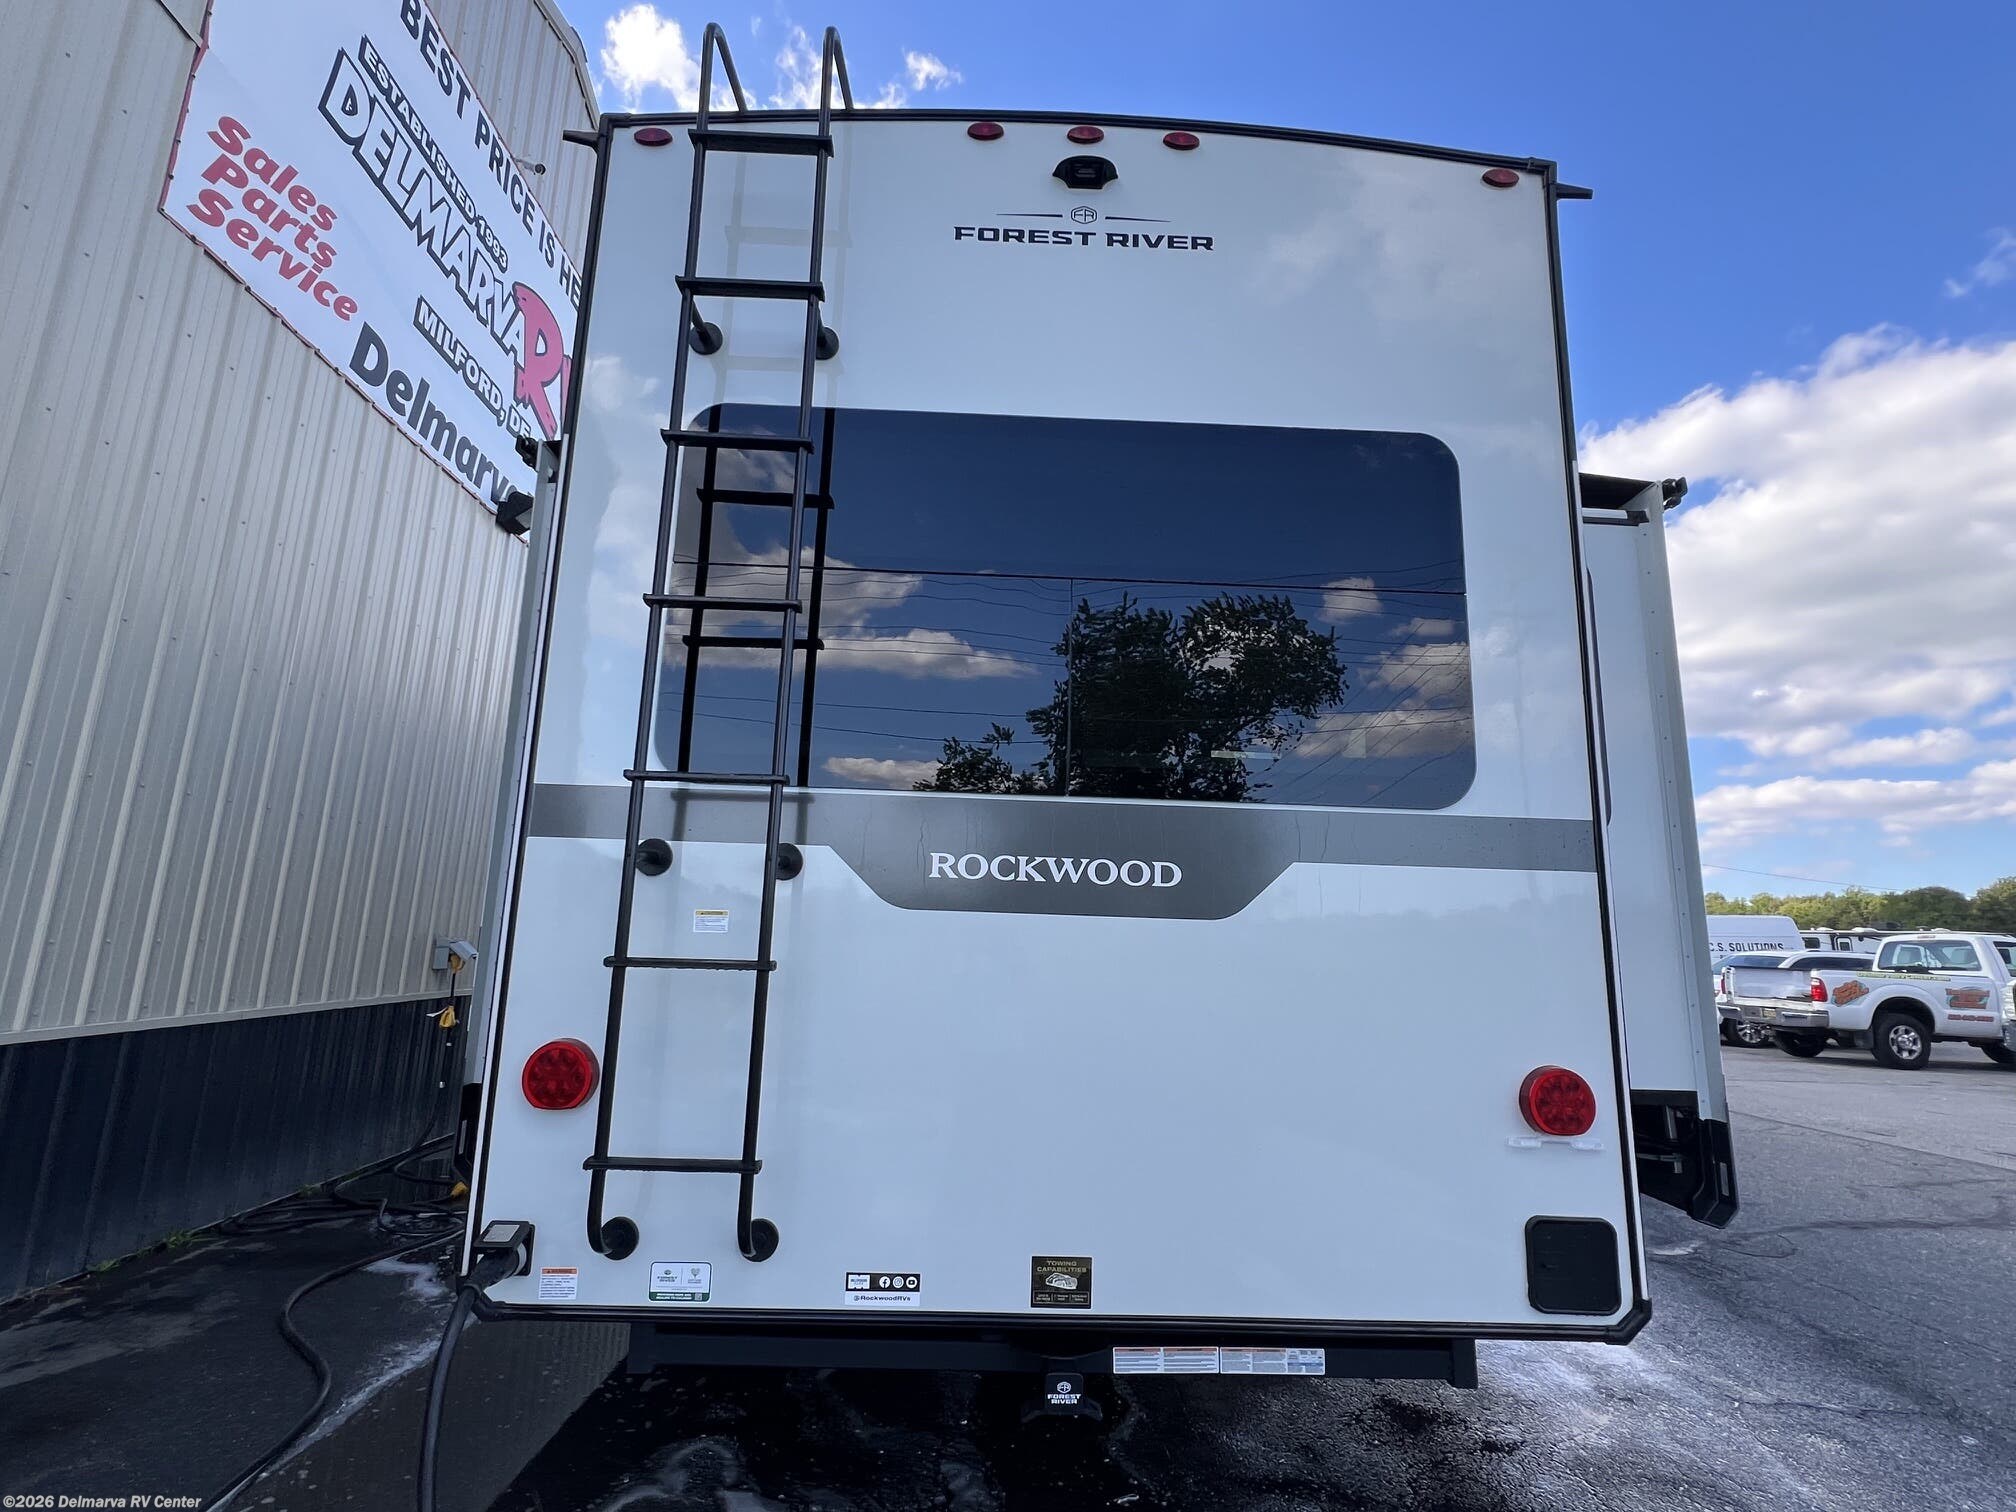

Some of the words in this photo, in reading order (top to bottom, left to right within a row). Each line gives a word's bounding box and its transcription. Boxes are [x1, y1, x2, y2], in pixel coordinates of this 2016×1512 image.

[207, 116, 338, 231] Sales
[359, 36, 476, 224] ESTABLISHED
[477, 216, 508, 273] 1993
[400, 0, 471, 119] BEST
[475, 110, 536, 236] PRICE
[539, 220, 556, 269] IS
[186, 189, 358, 321] Service
[201, 154, 338, 268] Parts
[319, 48, 527, 372] DELMARVA
[953, 226, 1097, 246] FOREST
[1105, 232, 1214, 251] RIVER
[413, 295, 505, 427] MILFORD,
[928, 852, 1183, 887] ROCKWOOD
[1728, 942, 1784, 952] SOLUTIONS
